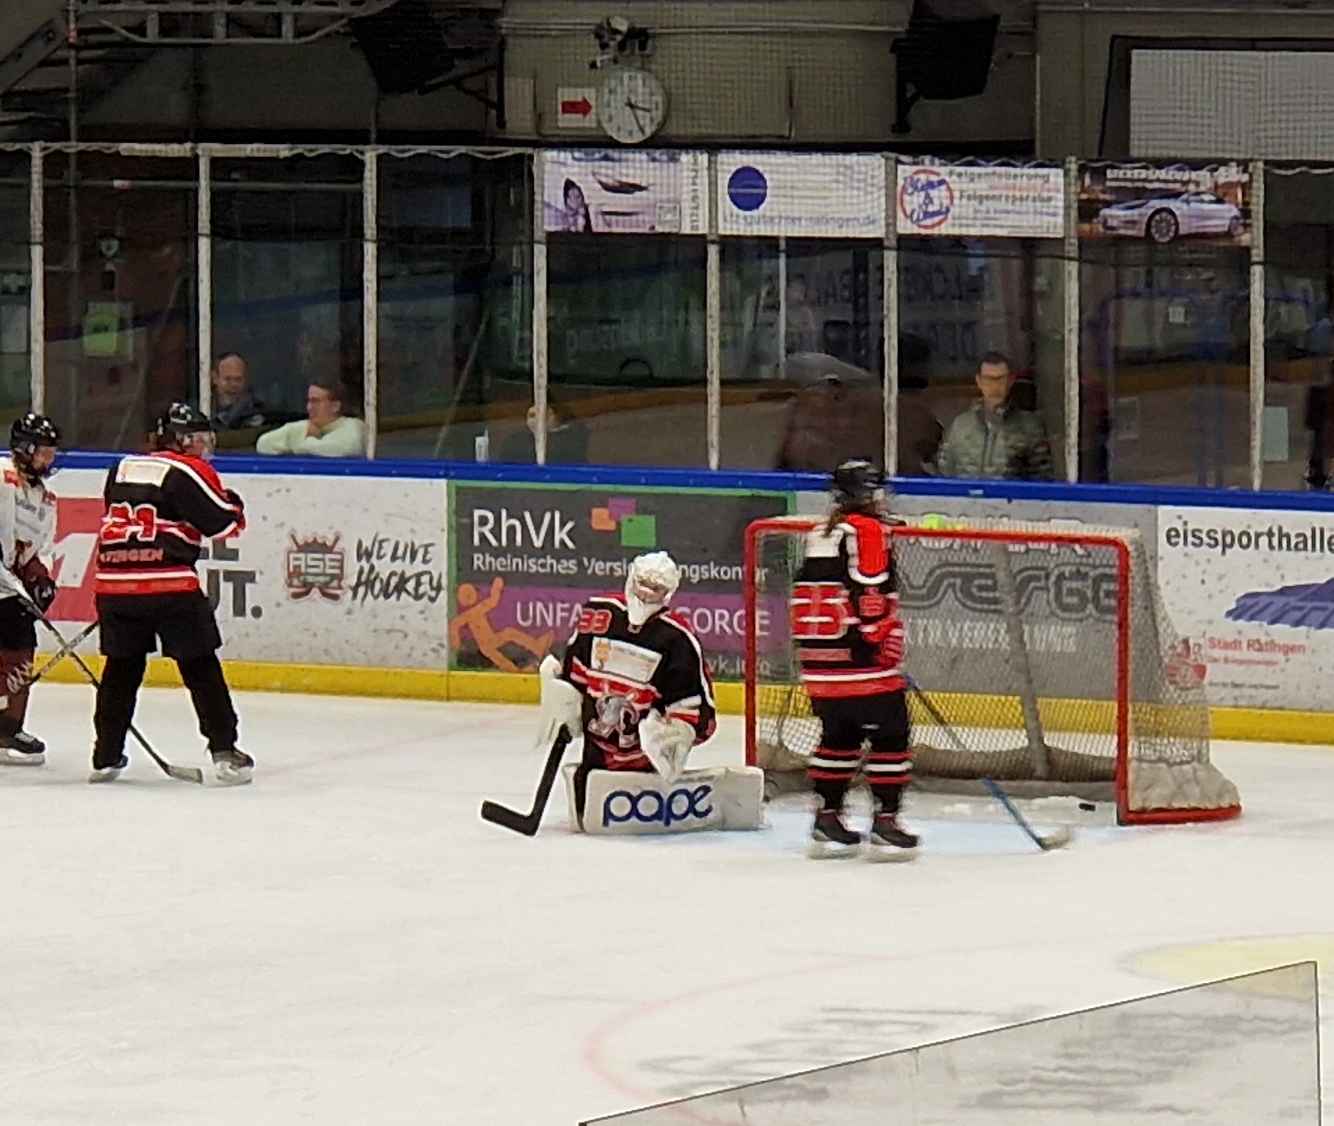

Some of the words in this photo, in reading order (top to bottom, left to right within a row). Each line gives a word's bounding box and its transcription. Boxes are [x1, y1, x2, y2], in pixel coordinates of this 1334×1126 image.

[472, 508, 576, 550] RhVk
[289, 552, 344, 575] ASE
[472, 553, 578, 575] Rheinisches
[349, 563, 444, 607] HOCKEY
[1207, 636, 1243, 652] Stadt
[1247, 638, 1307, 657] Ratingen
[602, 784, 713, 828] pape
